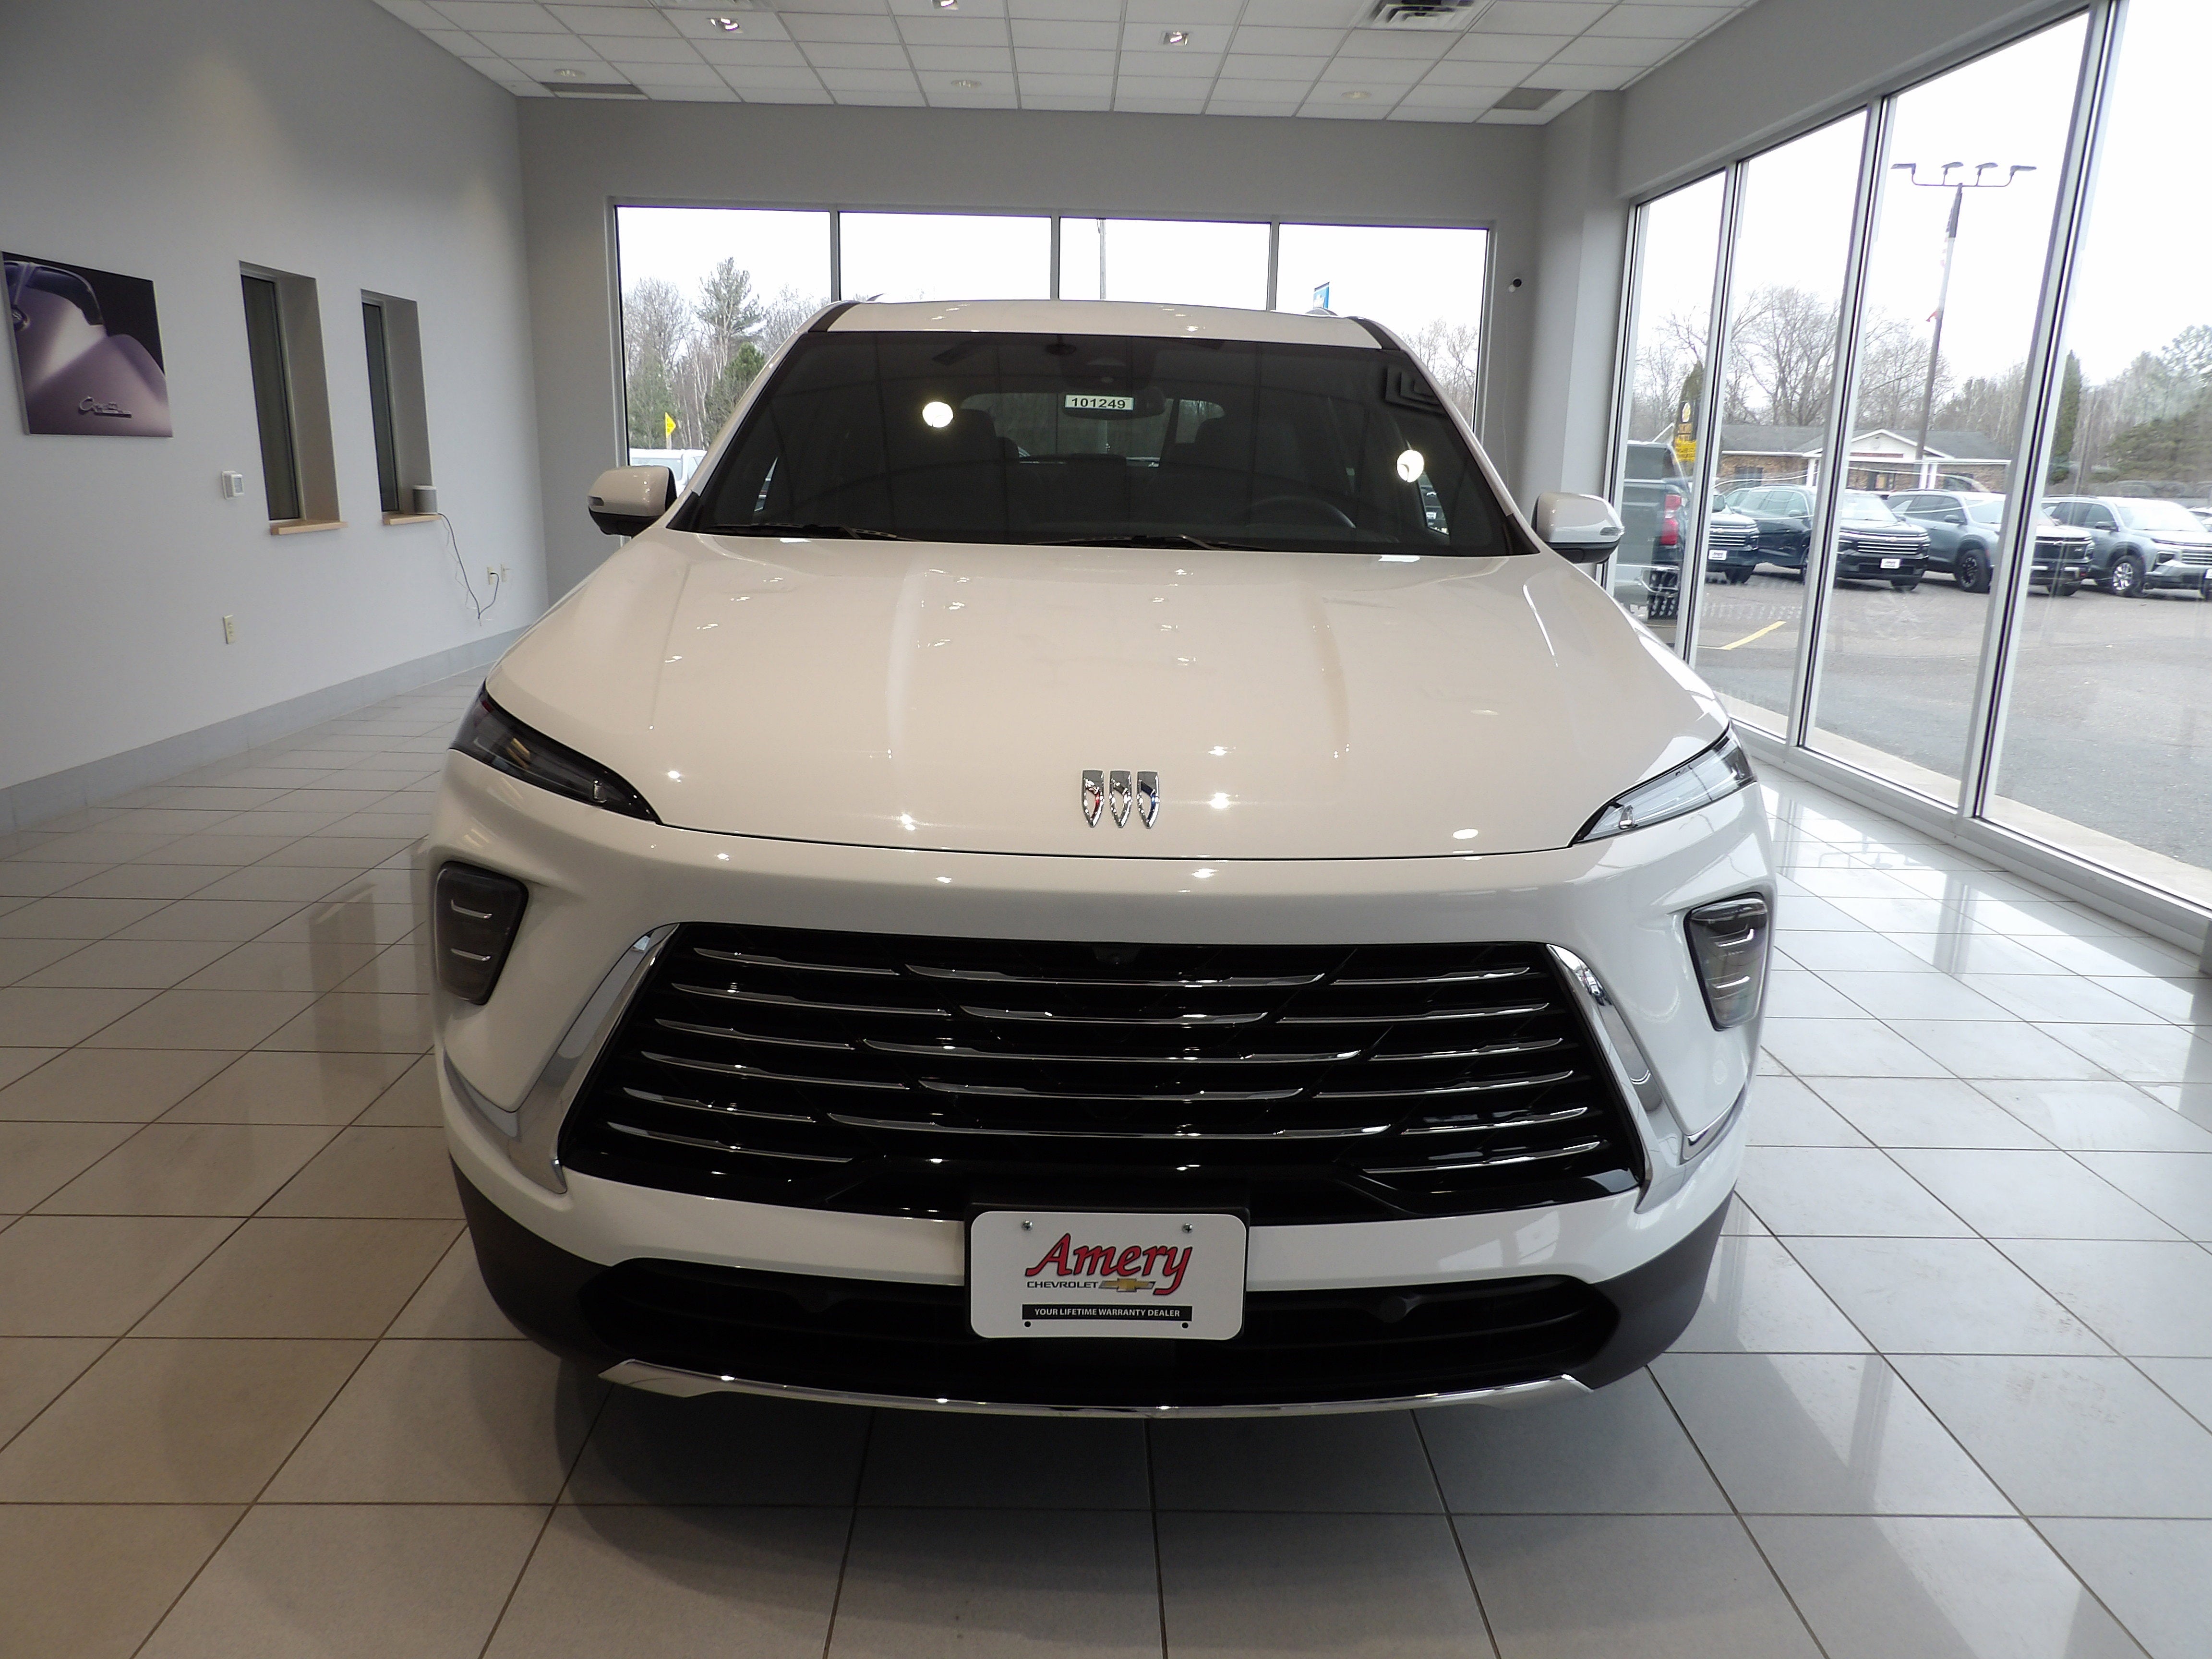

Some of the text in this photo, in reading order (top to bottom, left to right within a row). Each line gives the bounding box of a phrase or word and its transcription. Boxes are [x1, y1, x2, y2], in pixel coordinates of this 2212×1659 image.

[1071, 397, 1126, 409] 101249
[1025, 1233, 1193, 1295] Amery
[1147, 1309, 1180, 1317] DEALER
